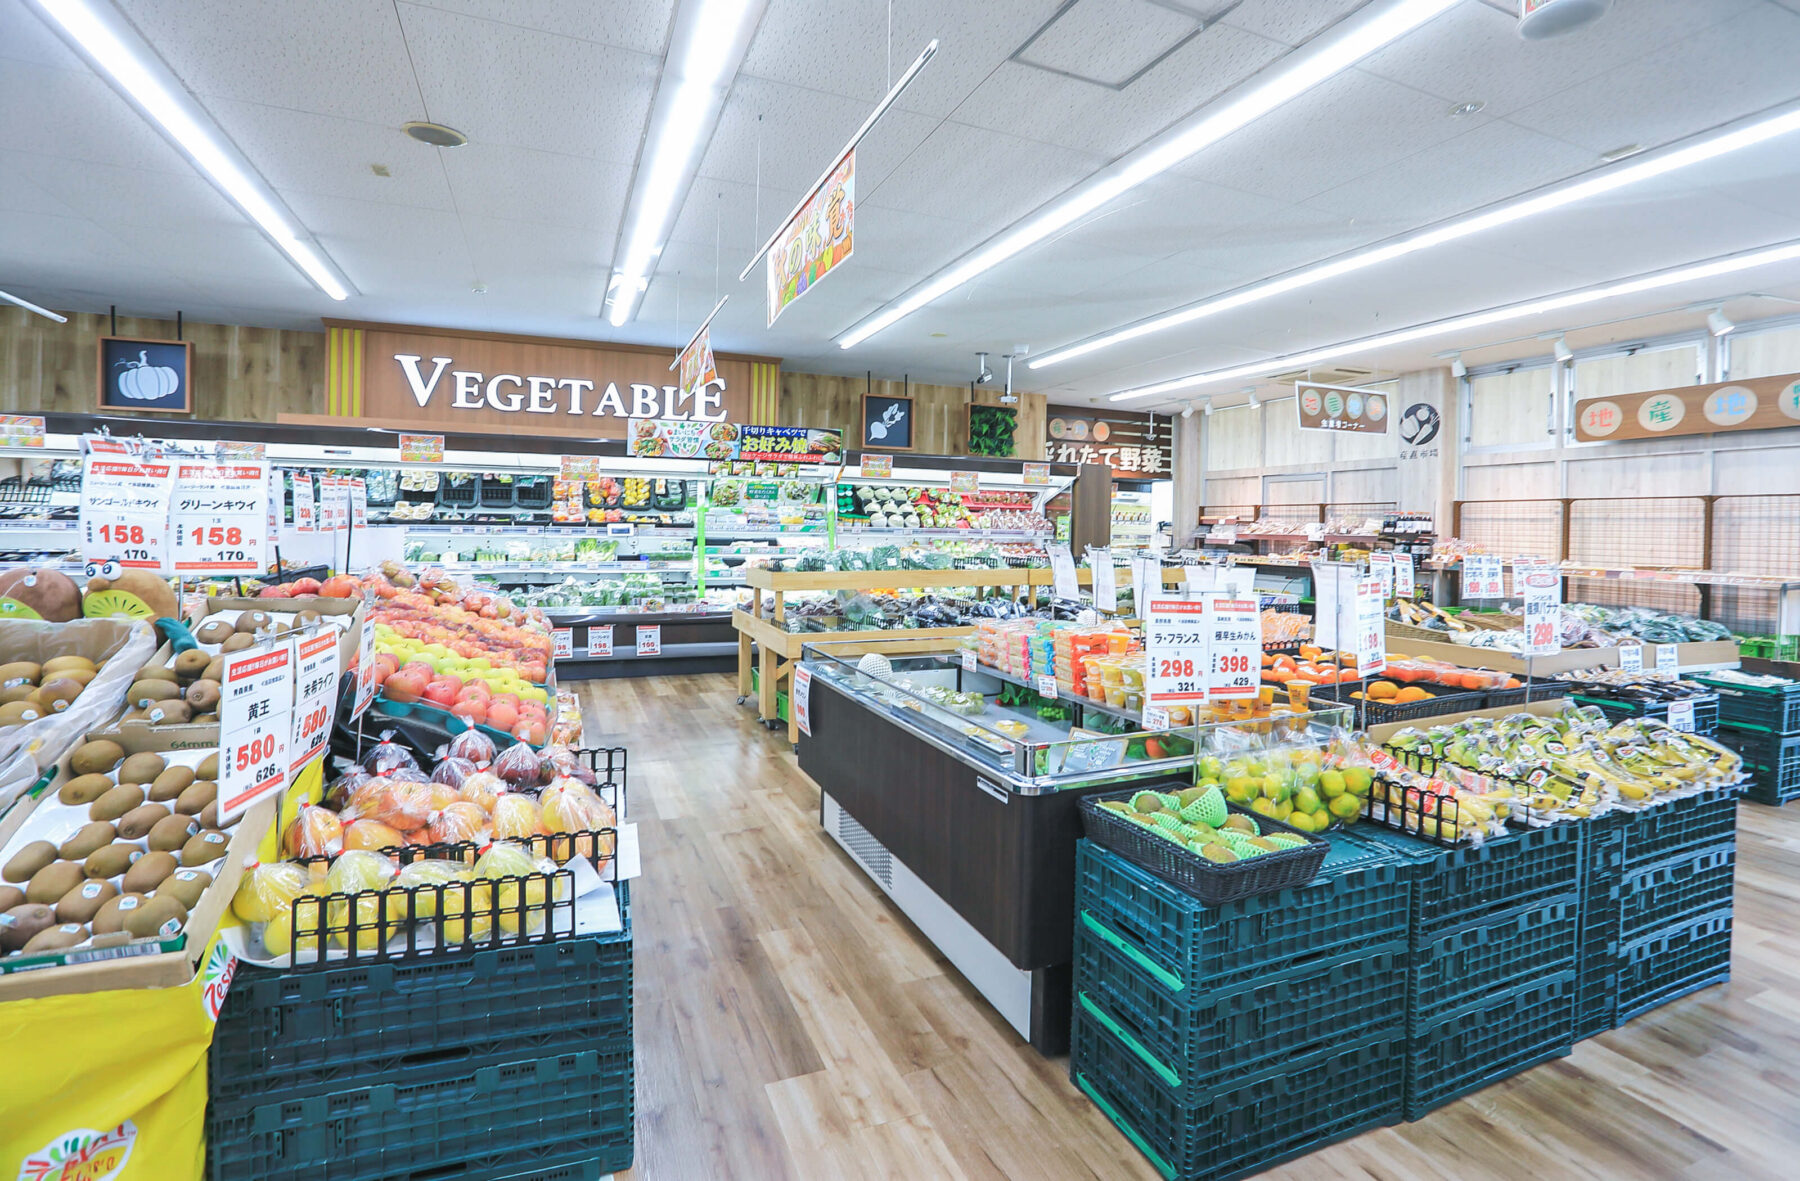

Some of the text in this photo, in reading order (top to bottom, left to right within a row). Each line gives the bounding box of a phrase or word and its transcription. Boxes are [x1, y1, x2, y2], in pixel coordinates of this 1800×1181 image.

[394, 353, 728, 422] VEGETABLE
[743, 426, 807, 436] 千切りキャベツで
[742, 435, 808, 454] お好み焼
[180, 499, 256, 511] グリーンキウイ
[99, 524, 145, 545] 158
[191, 527, 242, 546] 158
[124, 549, 149, 560] 170
[217, 550, 244, 561] 170
[1154, 632, 1200, 644] ラ・フランス
[1215, 631, 1256, 641] 極早生みかん
[1533, 622, 1553, 645] 298
[1160, 659, 1194, 678] 298
[1219, 655, 1249, 673] 398
[1177, 682, 1195, 692] 321
[1233, 677, 1249, 686] 429
[247, 699, 270, 721] 黄王
[301, 705, 328, 739] 580
[236, 733, 285, 772] 580 円
[255, 763, 276, 783] 626
